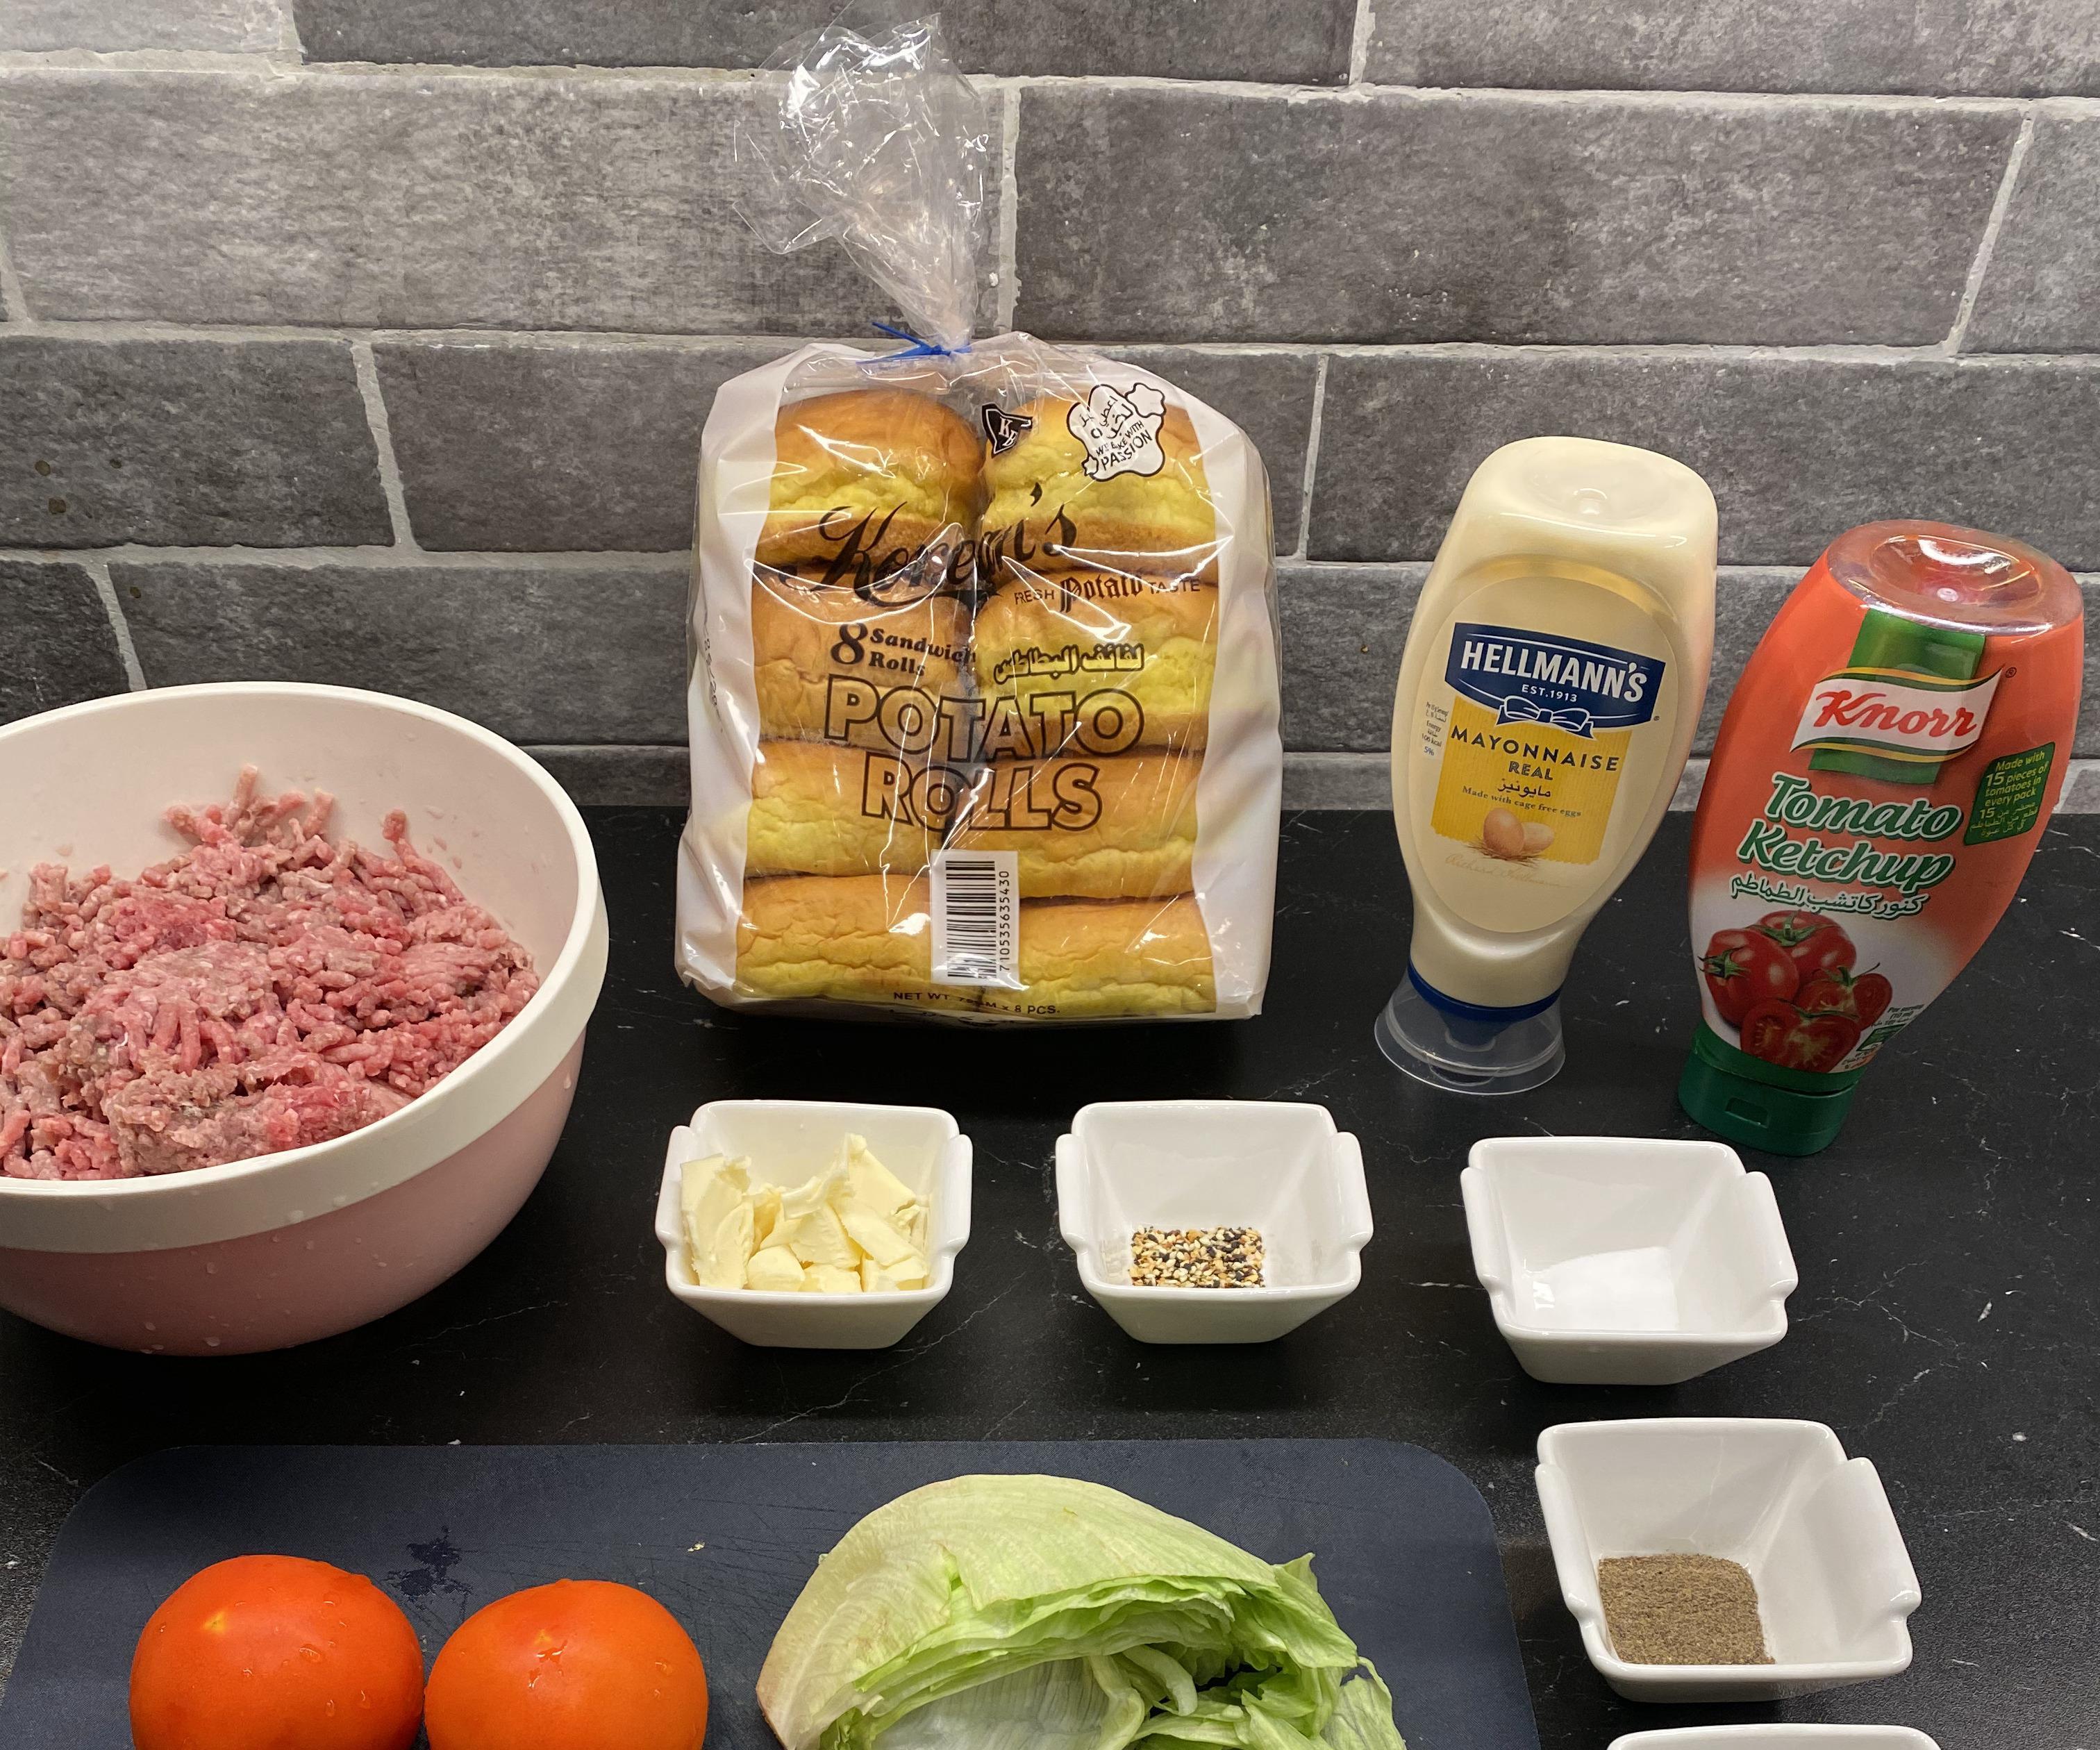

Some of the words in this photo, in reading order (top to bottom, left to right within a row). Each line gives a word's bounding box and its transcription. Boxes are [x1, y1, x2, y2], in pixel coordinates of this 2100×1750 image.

[1124, 420, 1144, 439] WITH
[1101, 430, 1153, 470] PASSION
[1014, 589, 1054, 605] FRESH
[1149, 578, 1201, 594] TASTE
[831, 622, 868, 665] 8
[869, 627, 976, 663] Sandwich
[869, 651, 926, 676] Rolls
[1460, 641, 1648, 702] HELLMANN'S
[1522, 684, 1577, 702] EST.1913
[824, 673, 1145, 760] POTATO
[1813, 690, 1978, 738] Knorr
[1451, 725, 1619, 772] MAYONNAISE
[1996, 758, 2023, 772] Made
[2026, 751, 2045, 765] with
[1508, 761, 1553, 781] REAL
[1986, 772, 2006, 786] 15
[2006, 767, 2036, 785] pieces
[2038, 760, 2049, 774] of
[862, 751, 1102, 832] ROLLS
[1497, 778, 1551, 798] مايونيز
[1985, 780, 2031, 797] tomatoes
[2033, 776, 2042, 785] in
[1985, 795, 2012, 806] every
[2013, 788, 2038, 803] pack
[1462, 785, 1488, 799] Made
[1491, 794, 1512, 804] with
[1514, 800, 1535, 810] cage
[1538, 803, 1557, 813] free
[1560, 809, 1582, 817] eggs
[1763, 771, 1964, 841] Tomato
[1980, 807, 1996, 819] 15
[1736, 819, 1956, 894] Ketchup
[1730, 872, 1806, 907] الطماطم
[1873, 893, 1929, 919] كنور
[999, 871, 1010, 972] 710535635430
[894, 992, 922, 1001] NET
[1015, 1005, 1022, 1013] 8
[1027, 1006, 1060, 1015] PCS.
